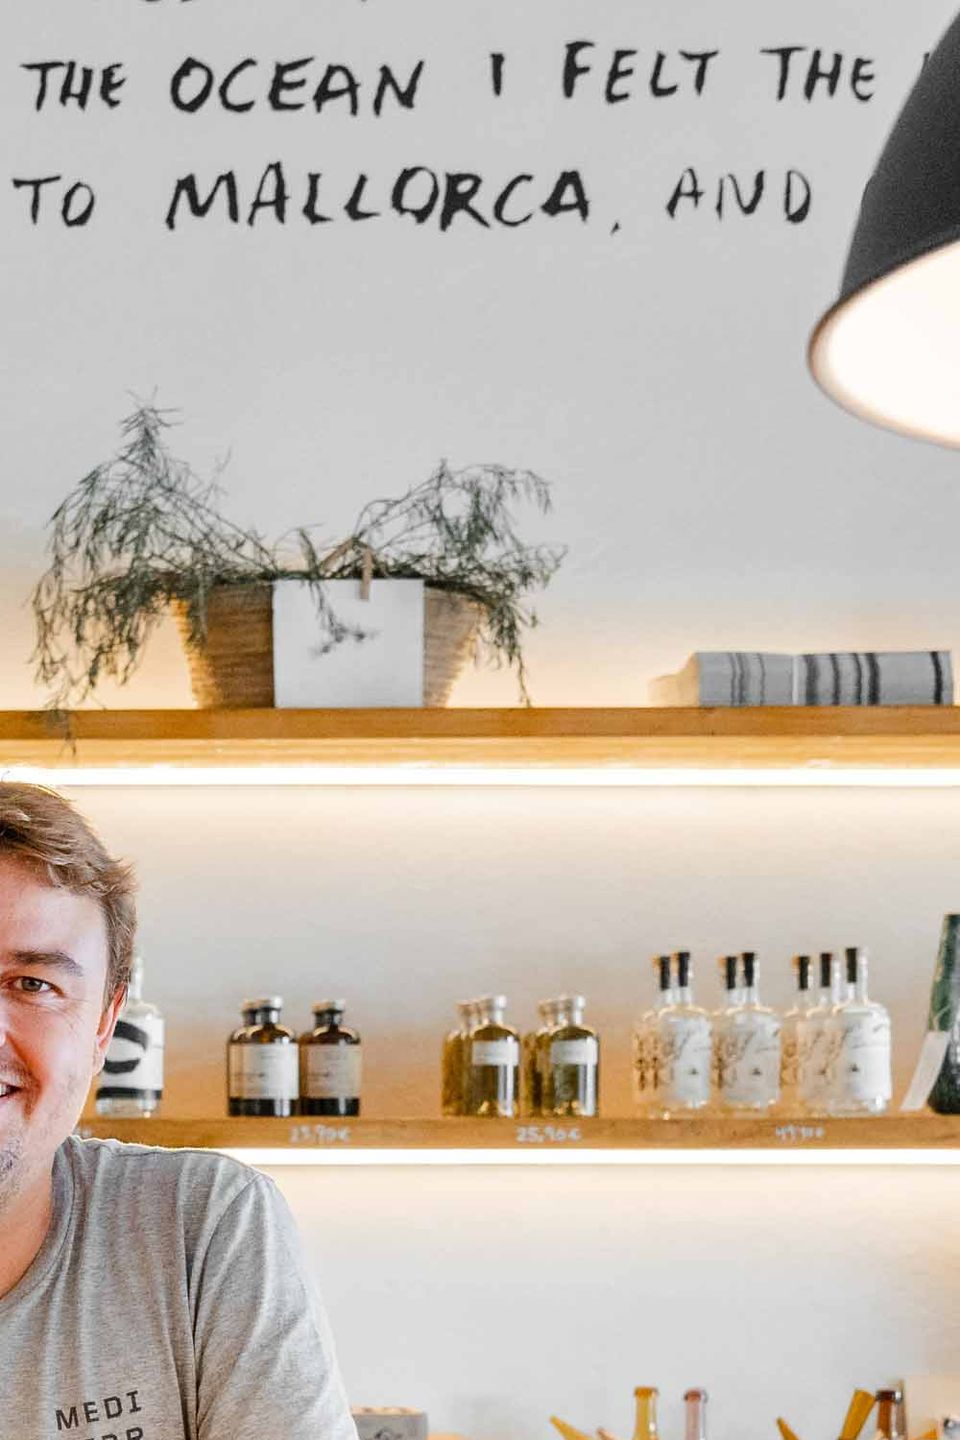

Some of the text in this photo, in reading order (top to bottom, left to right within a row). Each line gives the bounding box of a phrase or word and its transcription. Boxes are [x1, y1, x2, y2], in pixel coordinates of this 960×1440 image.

[22, 60, 126, 111] THE
[170, 56, 424, 116] OCEAN
[490, 53, 505, 96] I
[563, 40, 718, 104] FELT
[761, 46, 875, 101] THE
[12, 175, 95, 227] TO
[666, 168, 811, 224] AND
[55, 1390, 142, 1430] MEDI
